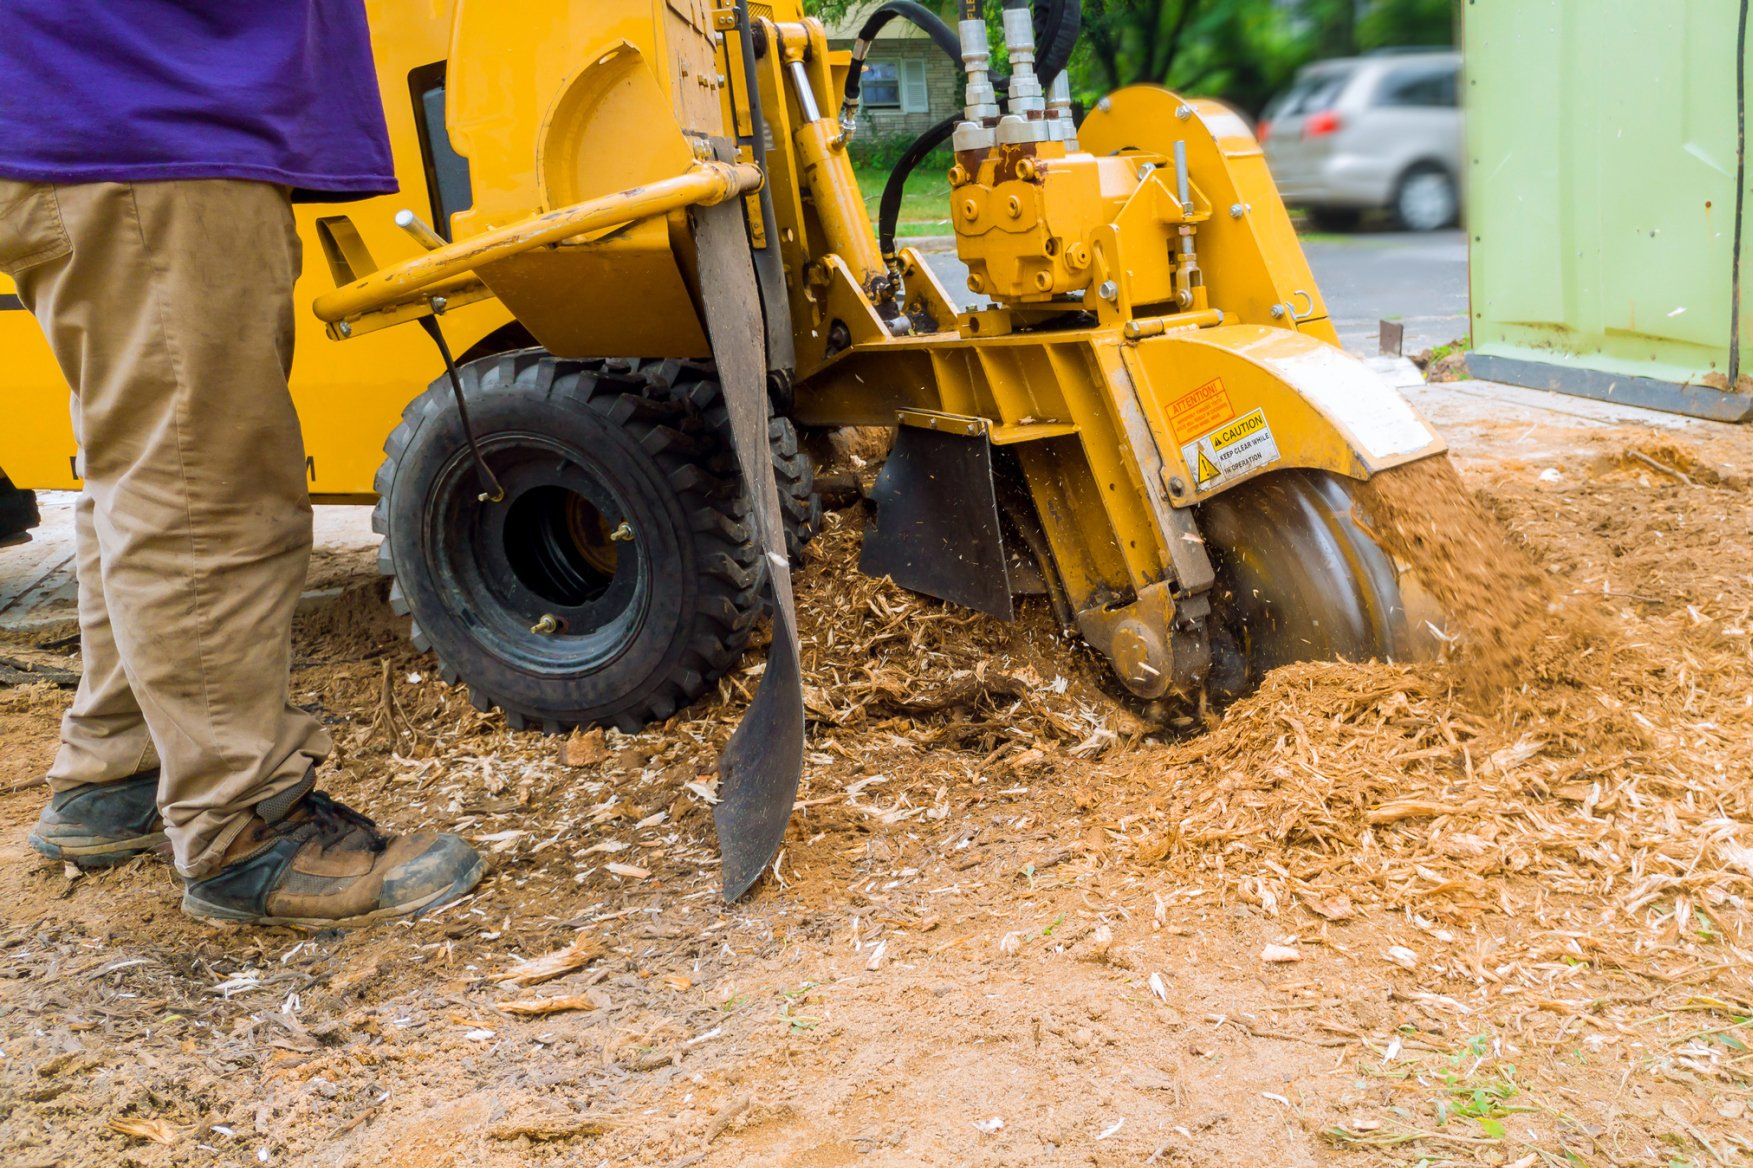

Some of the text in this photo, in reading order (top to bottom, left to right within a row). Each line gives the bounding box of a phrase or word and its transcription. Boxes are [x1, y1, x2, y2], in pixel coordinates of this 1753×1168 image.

[1172, 383, 1217, 414] ATTENTION!
[1222, 415, 1263, 442] CAUTION
[1219, 433, 1269, 461] KEEP CLEAR WHILE
[1224, 452, 1262, 475] IN OPERATION
